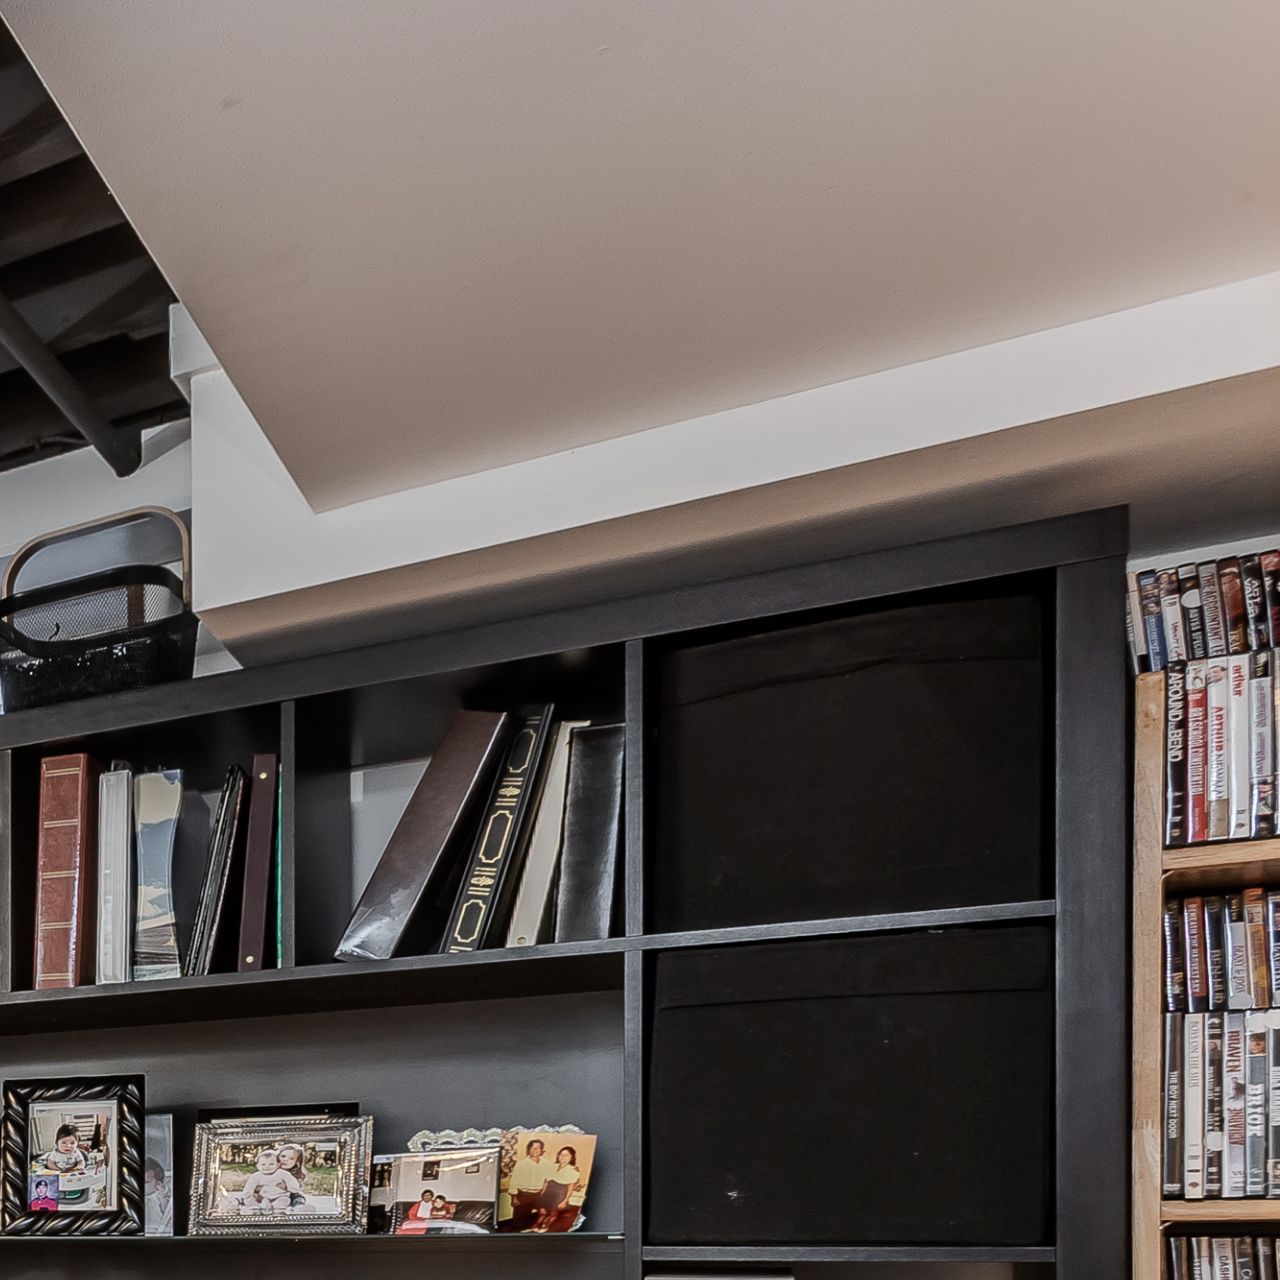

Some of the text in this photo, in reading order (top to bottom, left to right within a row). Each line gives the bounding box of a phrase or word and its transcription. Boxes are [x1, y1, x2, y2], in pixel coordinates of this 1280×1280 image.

[1201, 574, 1223, 640] THE ACCOUNTANT
[1168, 673, 1184, 722] AROUND
[1232, 665, 1245, 697] arthur
[1168, 729, 1184, 762] BEND
[1190, 1021, 1200, 1040] BOYS
[1227, 1031, 1241, 1073] BRAVEN
[1168, 1071, 1178, 1139] THE BOY NEXT DOOR
[1248, 1084, 1264, 1137] BRICK
